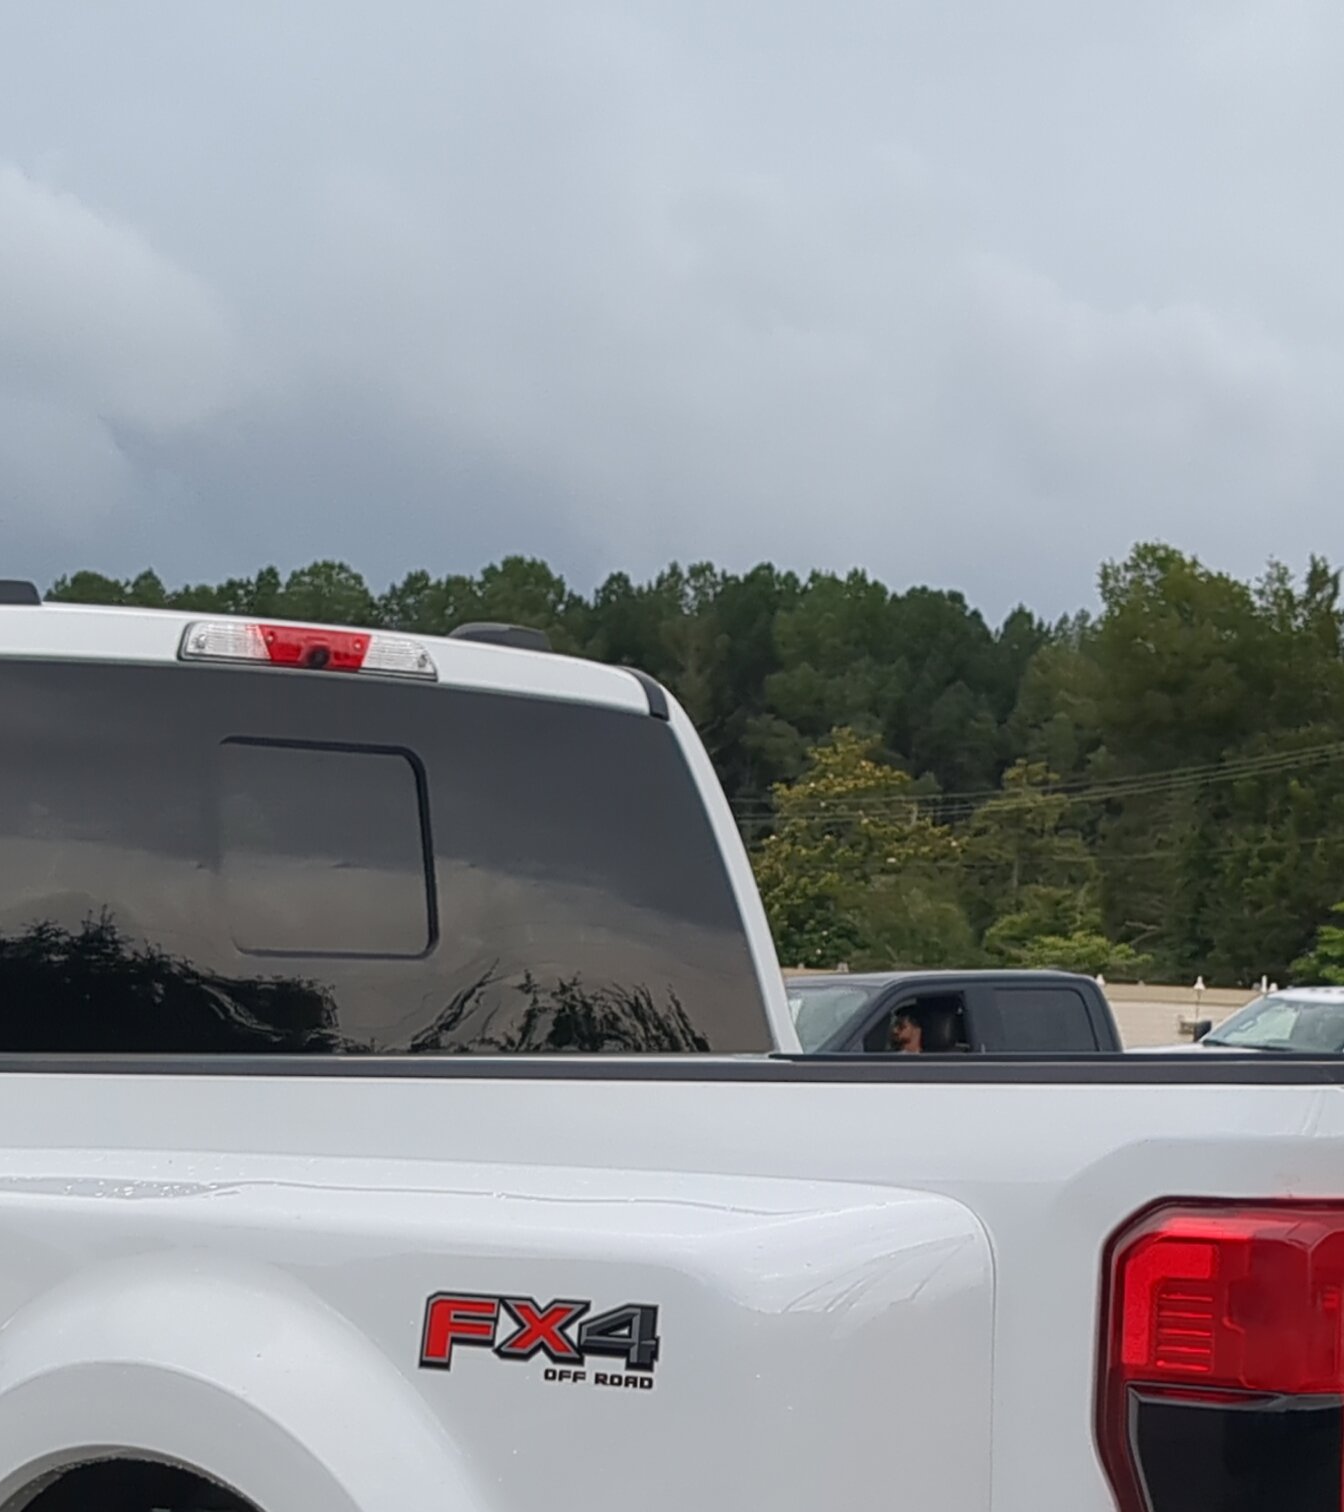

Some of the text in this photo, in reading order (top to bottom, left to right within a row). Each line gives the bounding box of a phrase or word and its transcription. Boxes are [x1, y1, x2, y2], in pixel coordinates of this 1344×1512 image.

[418, 1290, 660, 1372] FX4
[544, 1369, 653, 1389] OFF ROAD
